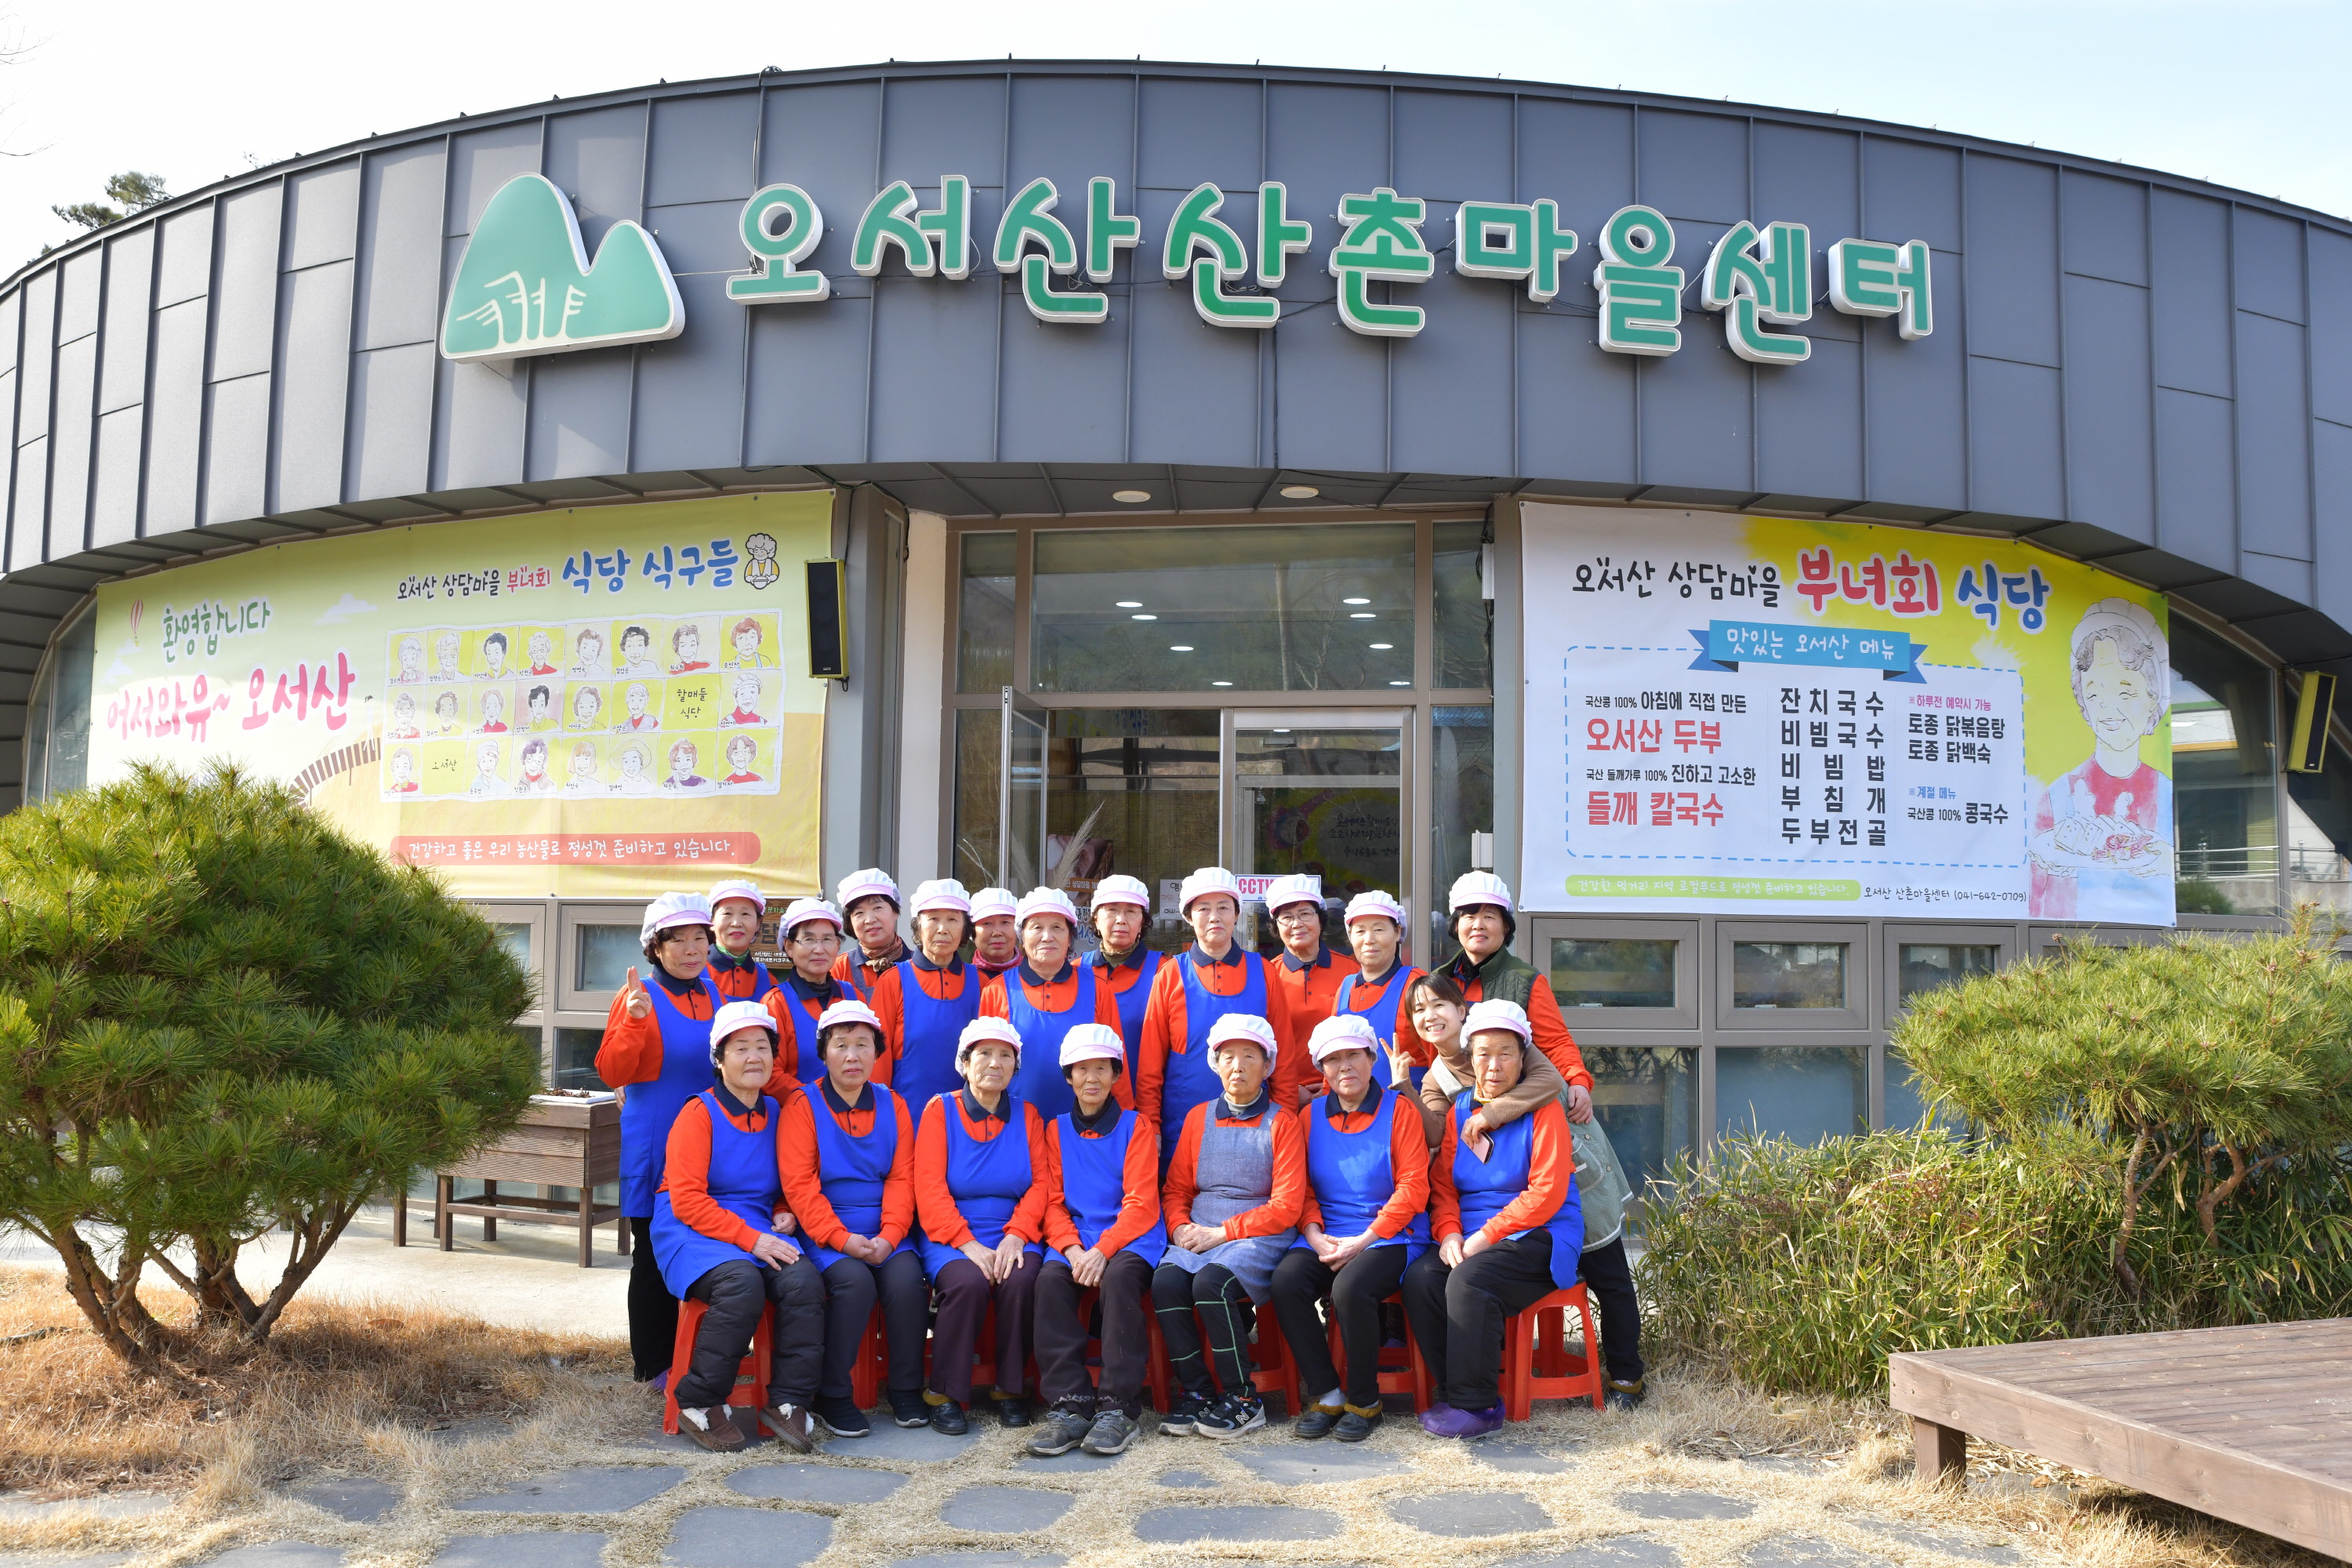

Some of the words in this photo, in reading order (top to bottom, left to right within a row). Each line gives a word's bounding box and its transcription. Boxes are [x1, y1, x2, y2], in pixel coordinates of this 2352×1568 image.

[397, 575, 437, 600] 오서산
[442, 569, 501, 597] 상담마을
[506, 566, 550, 593] 부녀회
[562, 550, 631, 594] 식당
[643, 539, 739, 590] 식구들
[1573, 557, 1656, 599] 오서산
[1668, 561, 1780, 608] 상담마을
[1797, 549, 1940, 615] 부녀회
[1958, 564, 2049, 630] 식당
[162, 601, 271, 663] 환영합니다
[1727, 628, 1784, 659] 맛있는
[1795, 635, 1850, 660] 오서산
[1860, 638, 1895, 661] 메뉴
[241, 652, 356, 731] 오서산
[677, 688, 708, 702] 할매들
[1585, 695, 1610, 708] 국산콩
[1614, 697, 1638, 708] 100%
[1641, 691, 1682, 710] 아침에
[1689, 692, 1715, 713] 직접
[1721, 694, 1747, 713] 만든
[681, 706, 702, 719] 식당
[1946, 696, 1972, 710] 예약시
[1975, 699, 1991, 712] 가능
[1587, 718, 1663, 753] 오서산
[1673, 720, 1722, 753] 두부
[1908, 713, 1939, 736] 토종
[1946, 715, 2005, 739] 닭볶음탕
[1908, 739, 1940, 762] 토종
[1946, 741, 1991, 764] 닭백숙
[432, 759, 458, 771] 오서산
[1586, 769, 1604, 781] 국산
[1607, 769, 1641, 782] 들깨가루
[1645, 770, 1668, 782] 100%
[1671, 764, 1713, 783] 진하고
[1718, 765, 1755, 786] 고소한
[1939, 786, 1957, 800] 메뉴
[1587, 790, 1638, 826] 들깨
[1650, 790, 1724, 827] 칼국수
[1907, 807, 1935, 821] 국산콩
[1938, 808, 1962, 822] 100%
[1965, 802, 2009, 825] 콩국수
[408, 840, 457, 859] 건강하고
[463, 840, 483, 861] 좋은
[488, 841, 510, 858] 우리
[517, 839, 561, 860] 농산물로
[568, 840, 608, 858] 정성껏
[614, 839, 667, 858] 준비하고
[674, 837, 735, 858] 있습니다.
[1577, 878, 1612, 892] 건강한
[1617, 880, 1648, 891] 먹거리
[1653, 880, 1674, 892] 지역
[1679, 880, 1727, 894] 로컬푸드로
[1731, 881, 1761, 895] 정성껏
[1766, 881, 1804, 895] 준비하고
[1808, 883, 1850, 897] 있습니다.
[1864, 886, 1891, 900] 오서산
[1895, 886, 1950, 902] 산촌마을센터
[1954, 889, 2027, 902] (041-642-0709)
